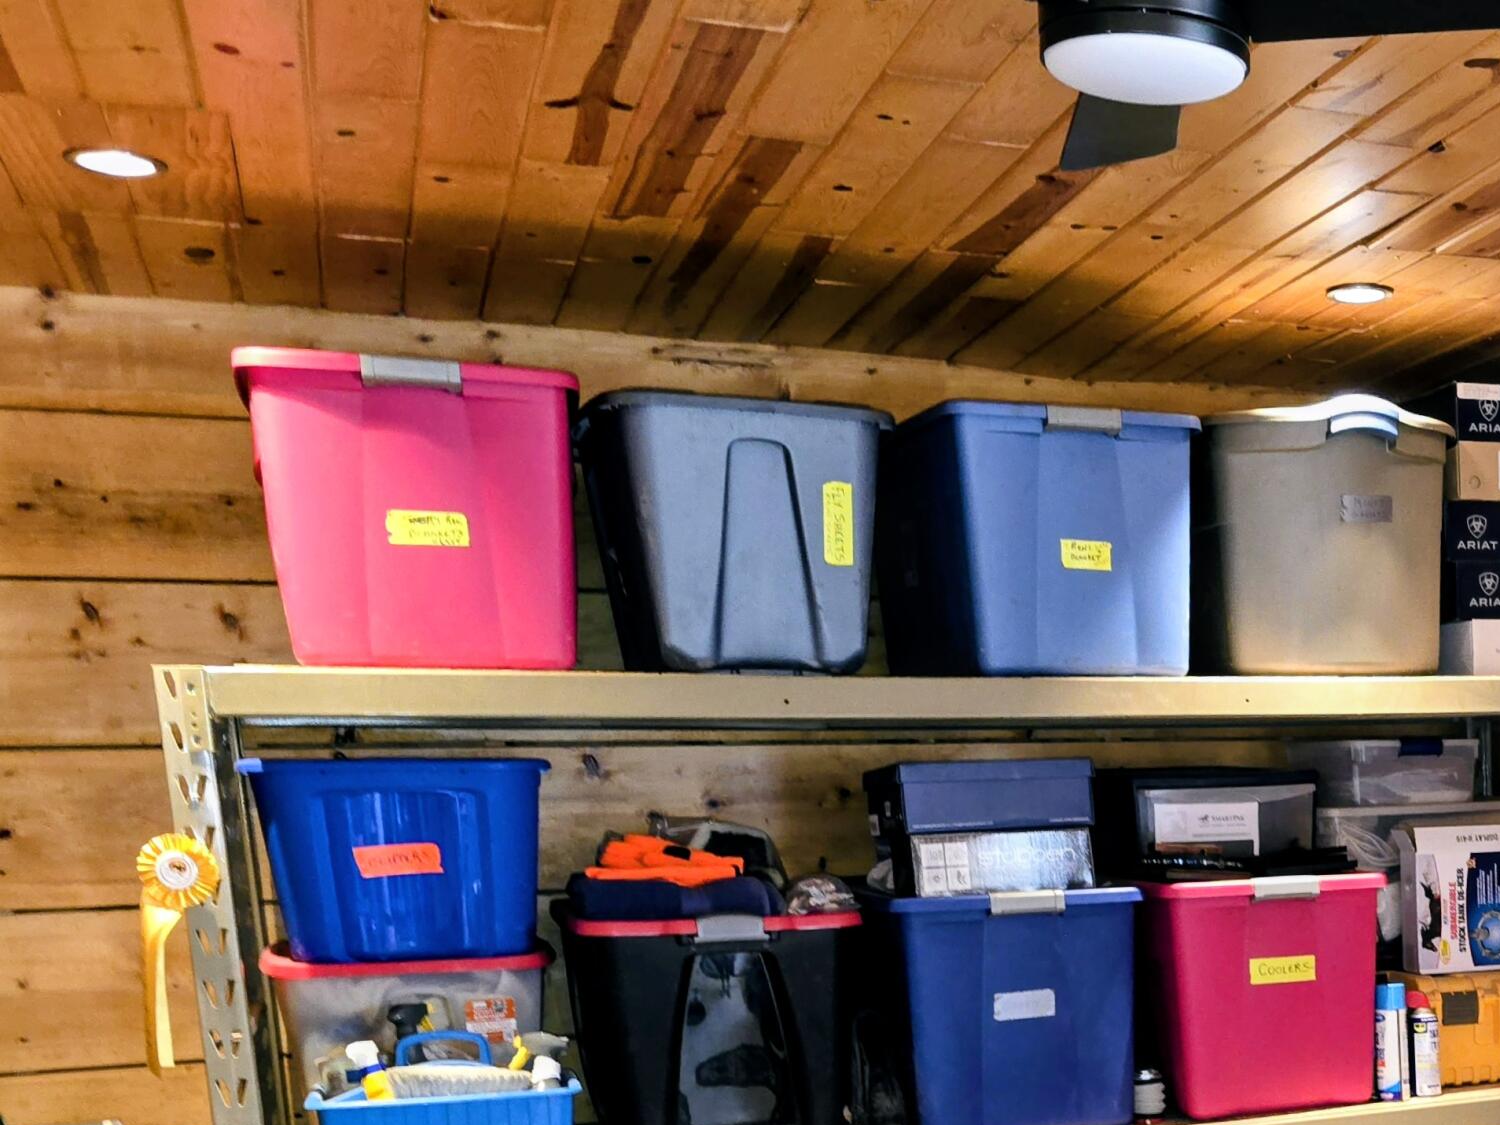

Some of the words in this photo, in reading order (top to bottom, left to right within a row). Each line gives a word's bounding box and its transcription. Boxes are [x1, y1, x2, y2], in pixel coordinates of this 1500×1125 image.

[1457, 540, 1499, 551] ARIAT
[1456, 868, 1465, 901] DE-ICER
[1457, 903, 1466, 924] TANK
[1458, 926, 1467, 953] STOCK
[1258, 961, 1313, 977] COOLERS
